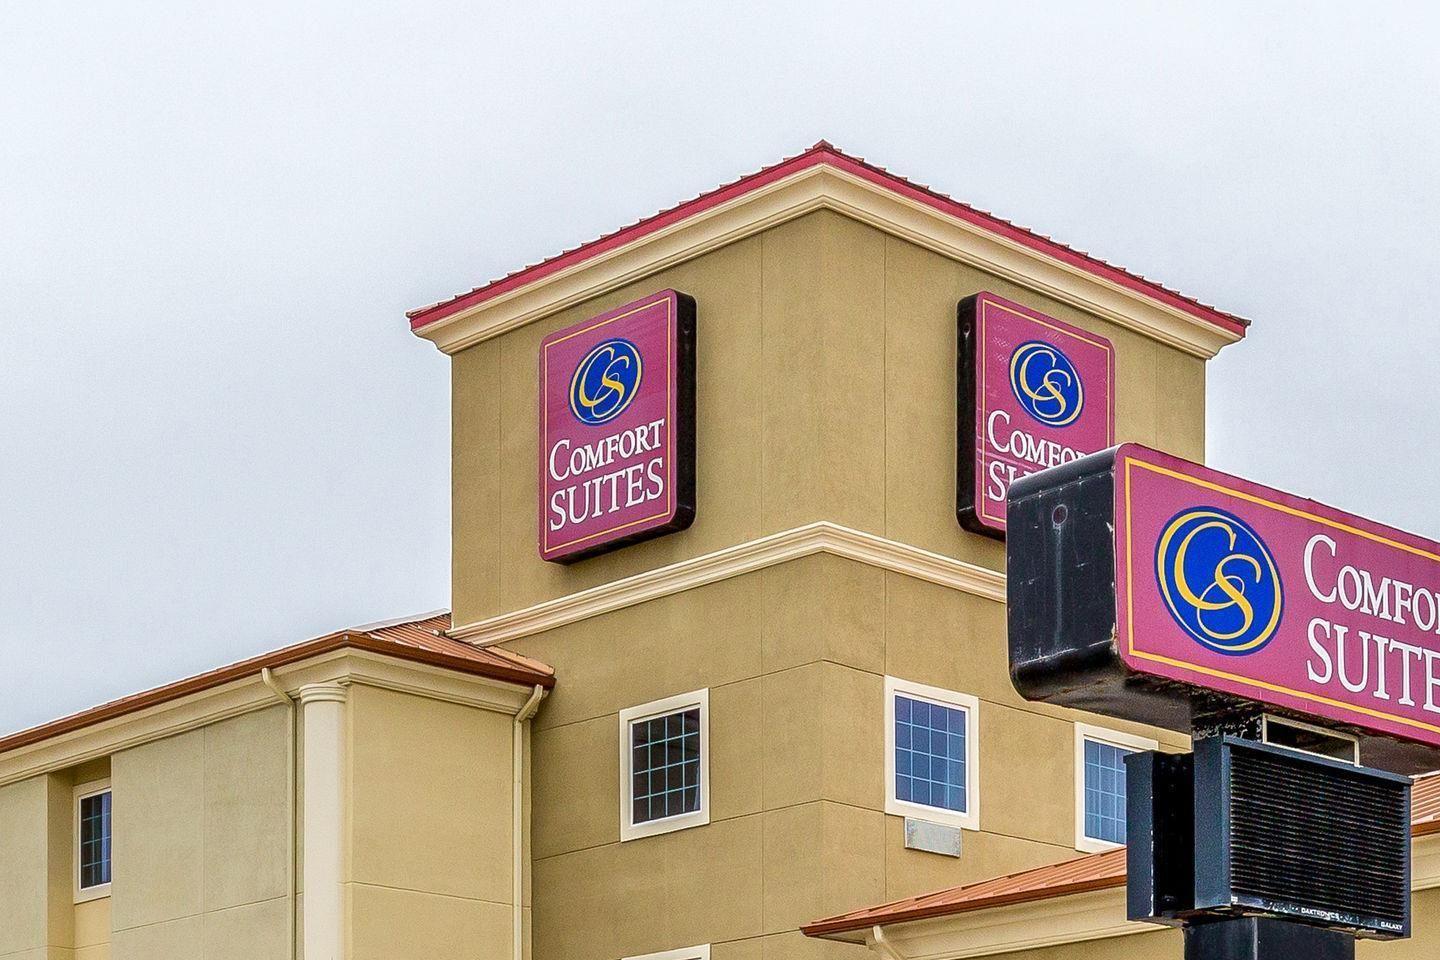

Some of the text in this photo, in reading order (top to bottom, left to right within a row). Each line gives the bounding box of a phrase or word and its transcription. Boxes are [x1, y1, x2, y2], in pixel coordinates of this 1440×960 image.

[549, 418, 665, 482] COMFORT
[987, 410, 1088, 469] COMFO
[550, 457, 664, 532] SUITES
[1380, 921, 1403, 930] GALAXY
